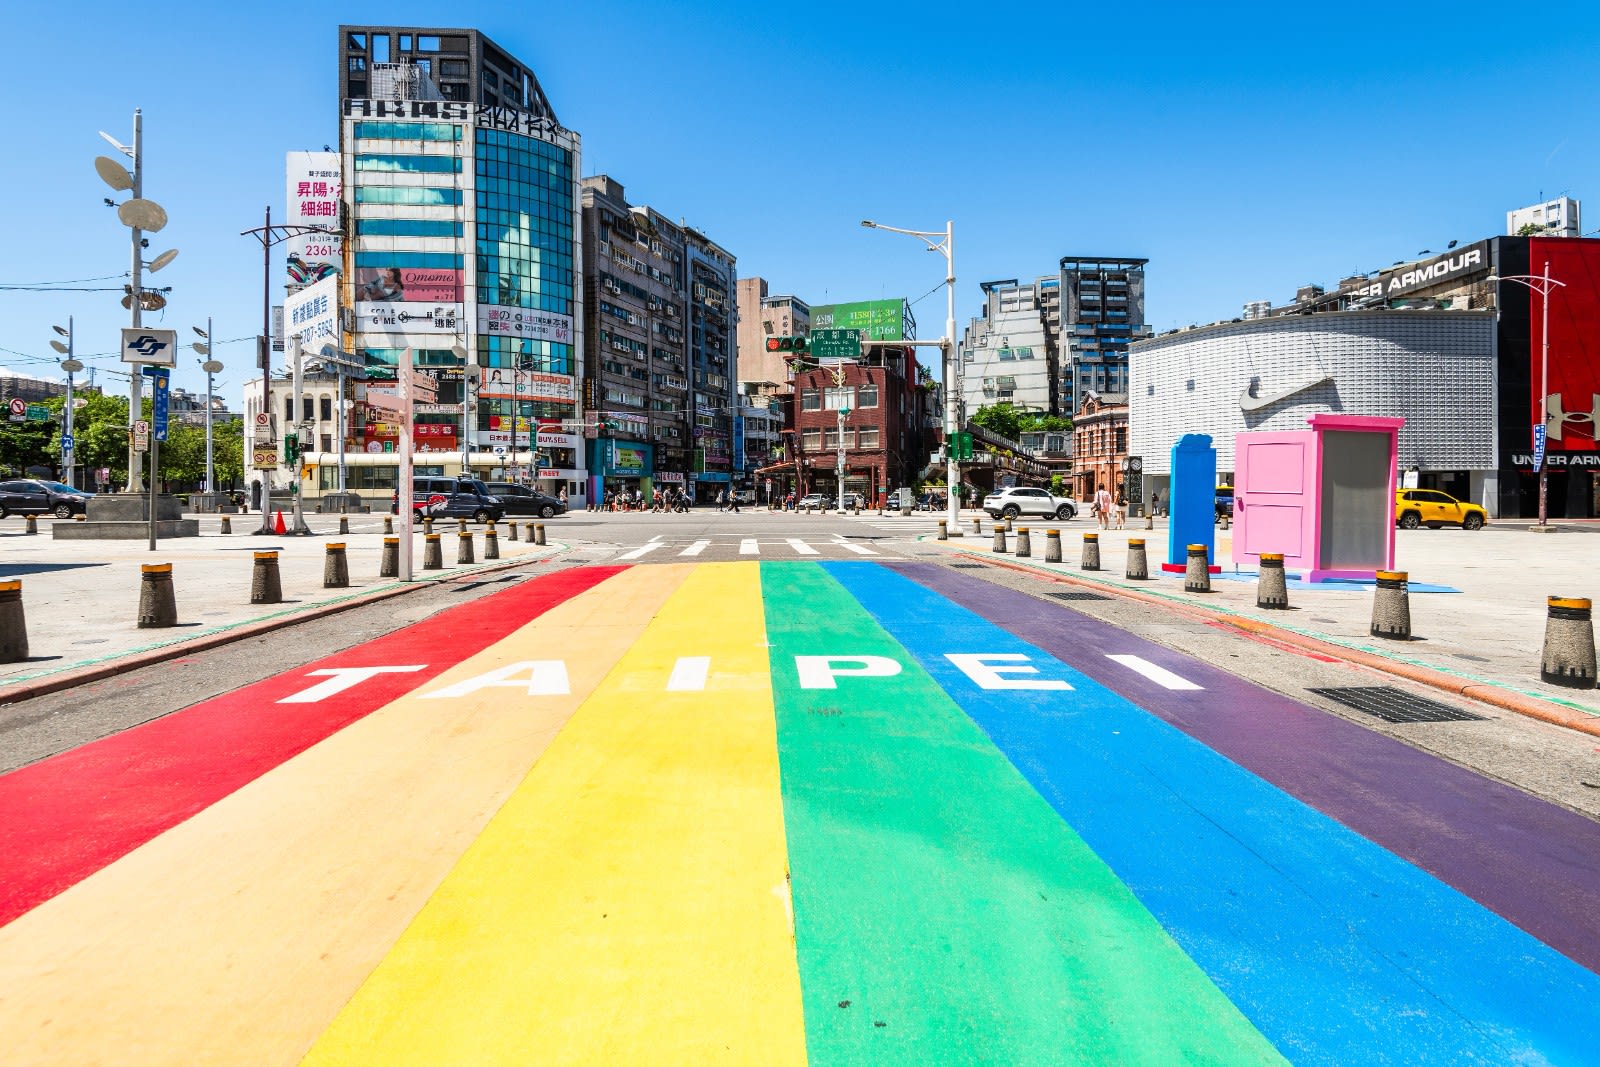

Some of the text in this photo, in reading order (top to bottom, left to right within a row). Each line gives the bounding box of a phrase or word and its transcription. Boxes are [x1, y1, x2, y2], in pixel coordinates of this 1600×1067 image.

[1387, 249, 1481, 293] ARMOUR
[306, 467, 313, 481] 1
[1511, 454, 1568, 465] UNER
[275, 653, 1206, 704] TAIPEI
